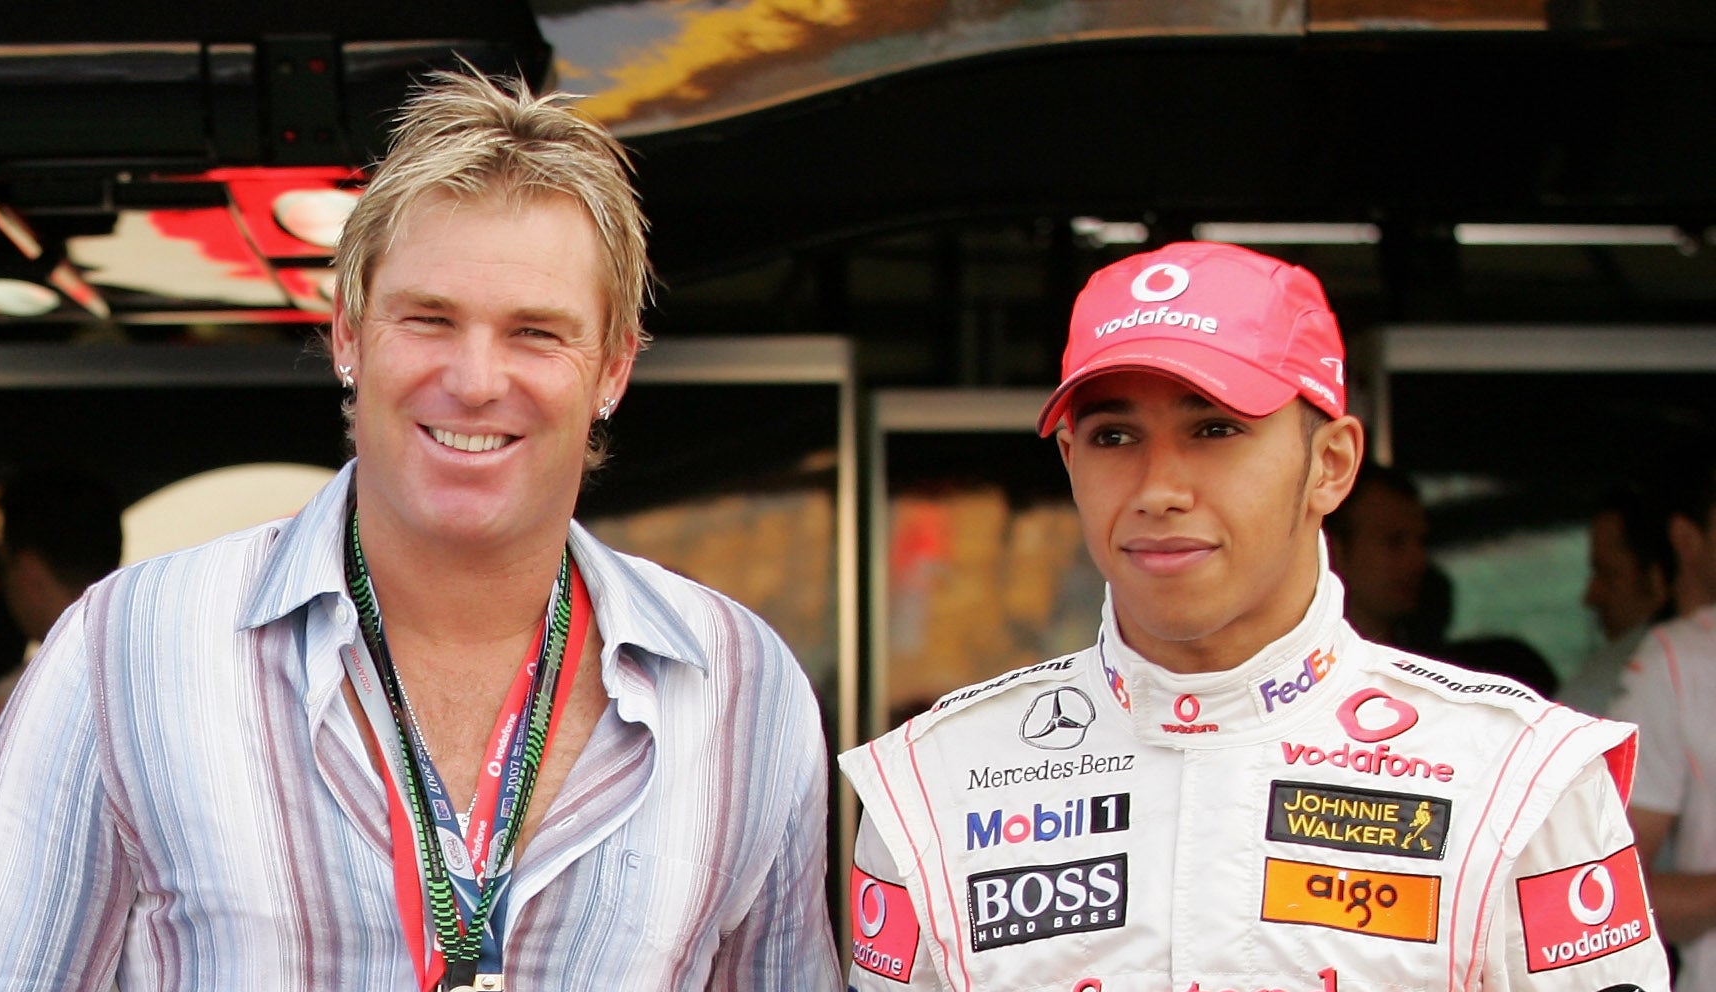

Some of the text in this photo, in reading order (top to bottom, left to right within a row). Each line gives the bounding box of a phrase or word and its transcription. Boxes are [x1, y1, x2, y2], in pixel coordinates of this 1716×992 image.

[1095, 306, 1218, 338] vodafone
[1260, 643, 1336, 713] FedEx
[495, 713, 518, 760] vodafone
[506, 760, 520, 793] 2007
[967, 752, 1135, 791] Mercedes-Benz
[1281, 741, 1455, 782] vodafone
[967, 799, 1085, 851] Mobil
[1283, 789, 1400, 822] JOHNNIE
[1288, 813, 1398, 848] WALKER
[973, 862, 1120, 926] BOSS
[1305, 871, 1399, 928] aigo
[978, 908, 1117, 942] HUGO BOSS
[1541, 918, 1642, 963] vodafone
